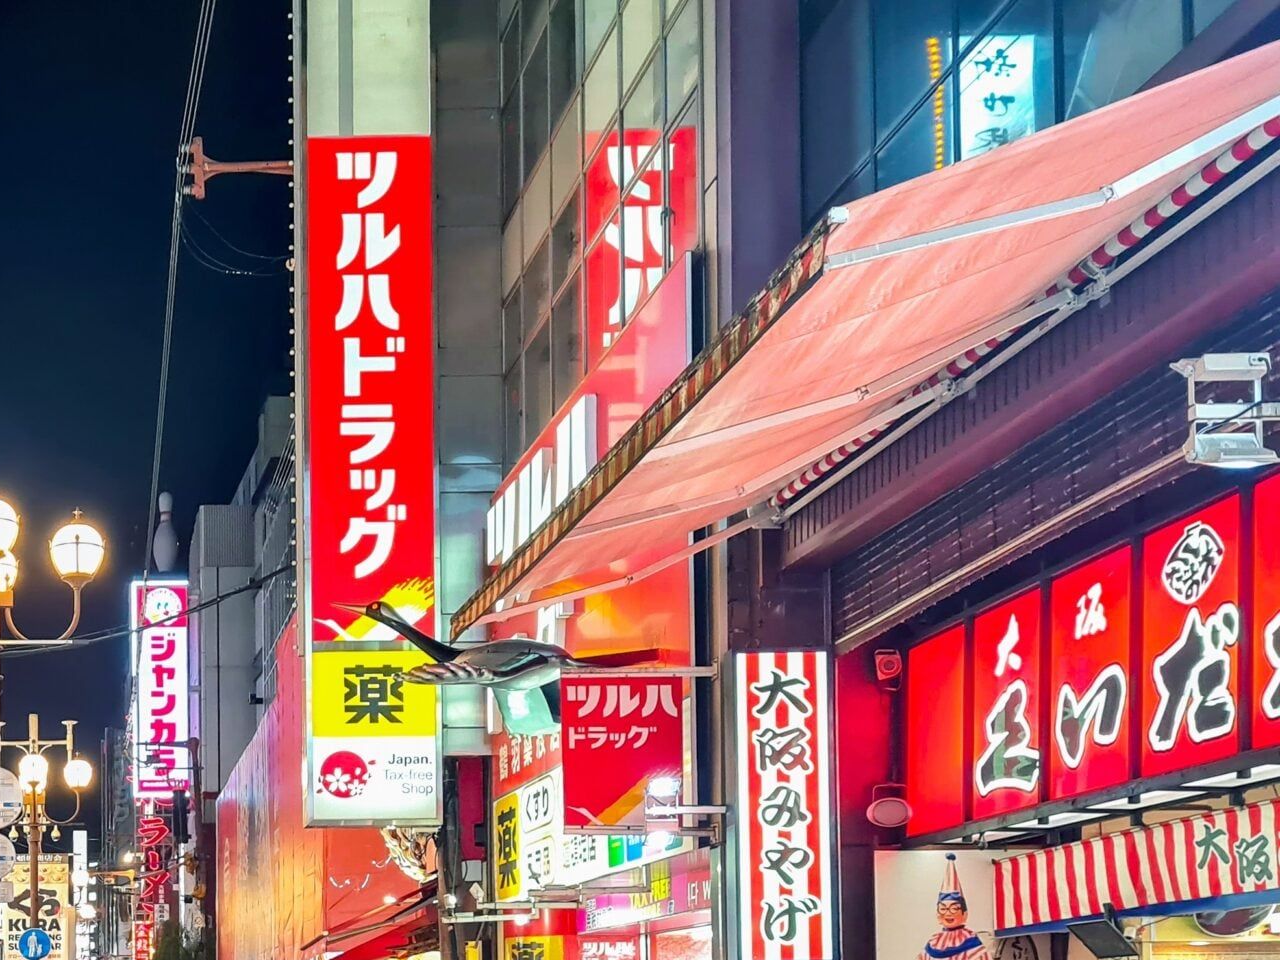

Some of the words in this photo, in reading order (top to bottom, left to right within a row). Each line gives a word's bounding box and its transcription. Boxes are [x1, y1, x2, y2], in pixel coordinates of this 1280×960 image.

[334, 151, 406, 579] ツルハドラッグ
[994, 582, 1107, 678] 大阪
[344, 665, 404, 724] 薬
[567, 685, 678, 718] ツルハ
[568, 726, 657, 749] ドラッグ
[384, 769, 433, 780] Tax-free
[388, 753, 433, 766] Japan.
[402, 783, 434, 796] Shop
[526, 786, 549, 821] くすり
[754, 670, 819, 942] 大阪みやげ
[1195, 821, 1274, 884] 大阪
